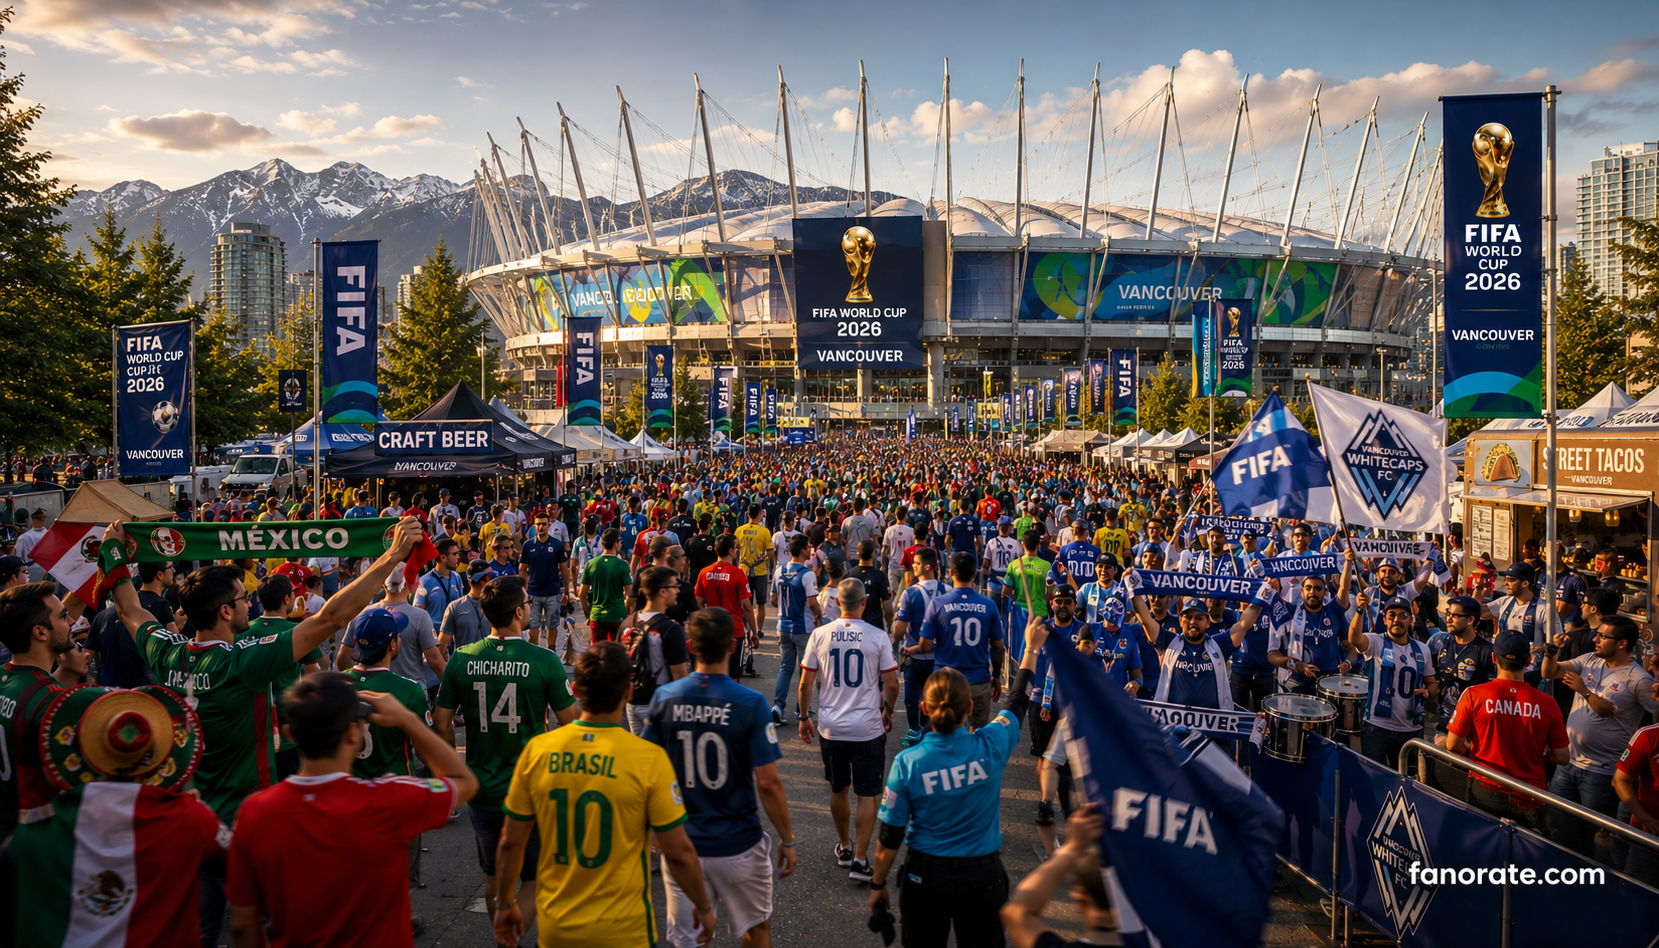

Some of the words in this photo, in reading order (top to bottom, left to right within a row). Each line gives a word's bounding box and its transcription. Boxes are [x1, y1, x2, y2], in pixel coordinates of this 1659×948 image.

[1465, 224, 1522, 243] FIFA
[1465, 246, 1522, 257] WORLD
[1478, 259, 1508, 270] CUP
[1465, 273, 1521, 291] 2026
[1118, 285, 1222, 300] VANCOUVER
[336, 265, 366, 356] FIFA
[813, 308, 837, 318] FIFA
[840, 308, 881, 318] WORLD
[884, 308, 906, 318] CUP
[837, 321, 882, 337] 2026
[1452, 330, 1534, 341] VANCOUVER
[127, 336, 162, 352] FIFA
[126, 352, 162, 364] WORLD
[164, 350, 184, 361] CUP
[576, 332, 594, 386] FIFA
[817, 350, 903, 362] VANCOUVER
[1222, 361, 1244, 369] 2026
[126, 366, 146, 376] CUP
[1119, 360, 1131, 398] FIFA
[126, 376, 164, 393] 2026
[718, 377, 728, 409] FIFA
[378, 430, 435, 449] CRAFT
[442, 430, 488, 448] BEER
[126, 449, 184, 460] VANCOUVER
[1346, 452, 1424, 472] WHITECAPS
[1543, 448, 1592, 472] SREET
[1596, 448, 1644, 473] TACOS
[1231, 446, 1293, 485] FIFA
[1378, 471, 1393, 481] FC
[218, 526, 349, 551] MÉXICO
[1151, 573, 1251, 595] VANCOUVER
[467, 660, 530, 677] CHICHARITO
[828, 648, 864, 688] 10
[472, 681, 522, 734] 14
[672, 703, 732, 726] MBAPPÉ
[1486, 699, 1541, 719] CANADA
[548, 752, 617, 780] BRASIL
[677, 730, 728, 790] 10
[922, 760, 988, 796] FIFA
[549, 788, 613, 869] 10
[1111, 787, 1219, 856] FIFA
